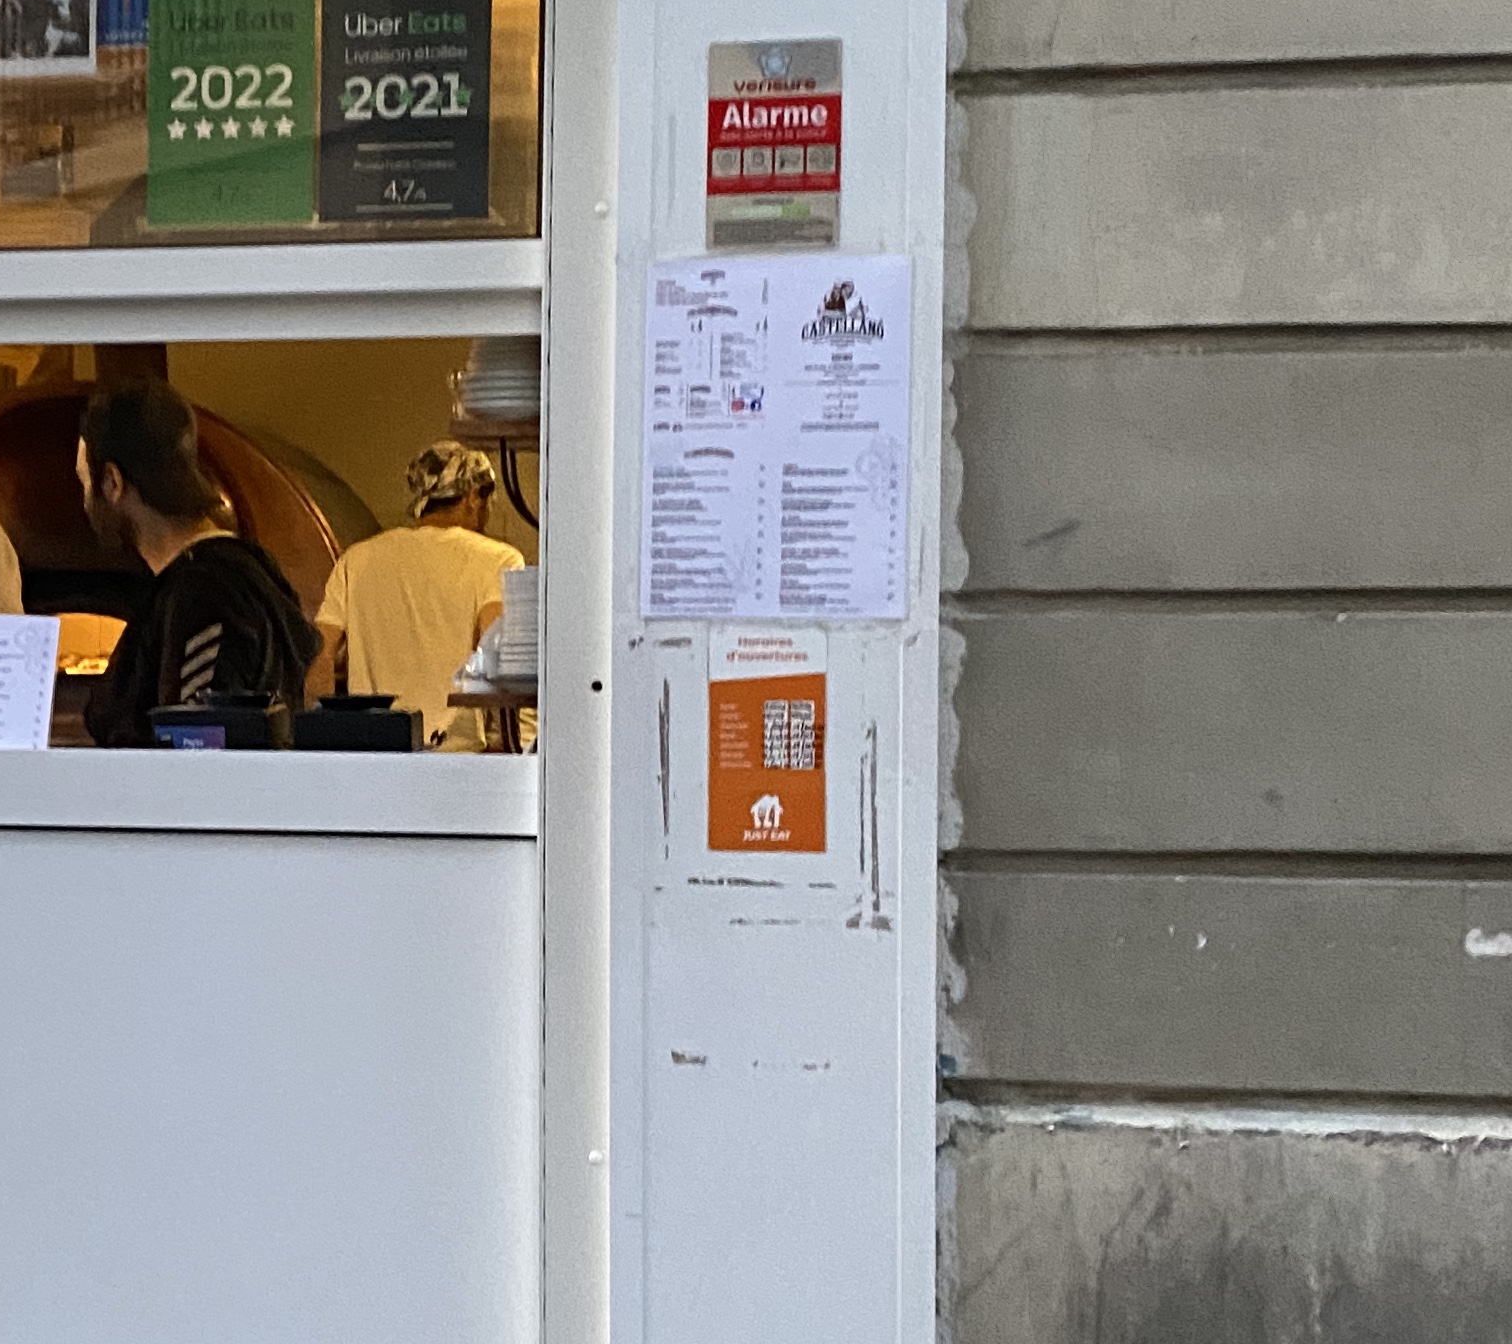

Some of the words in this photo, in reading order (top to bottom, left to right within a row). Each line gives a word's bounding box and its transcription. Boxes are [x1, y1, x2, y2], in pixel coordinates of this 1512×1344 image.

[344, 11, 403, 38] Uber
[407, 9, 468, 36] Eats
[170, 62, 294, 112] 2022
[344, 71, 469, 121] 2021
[722, 100, 828, 129] Alarme
[742, 829, 768, 842] JUST
[769, 829, 791, 842] EAT
